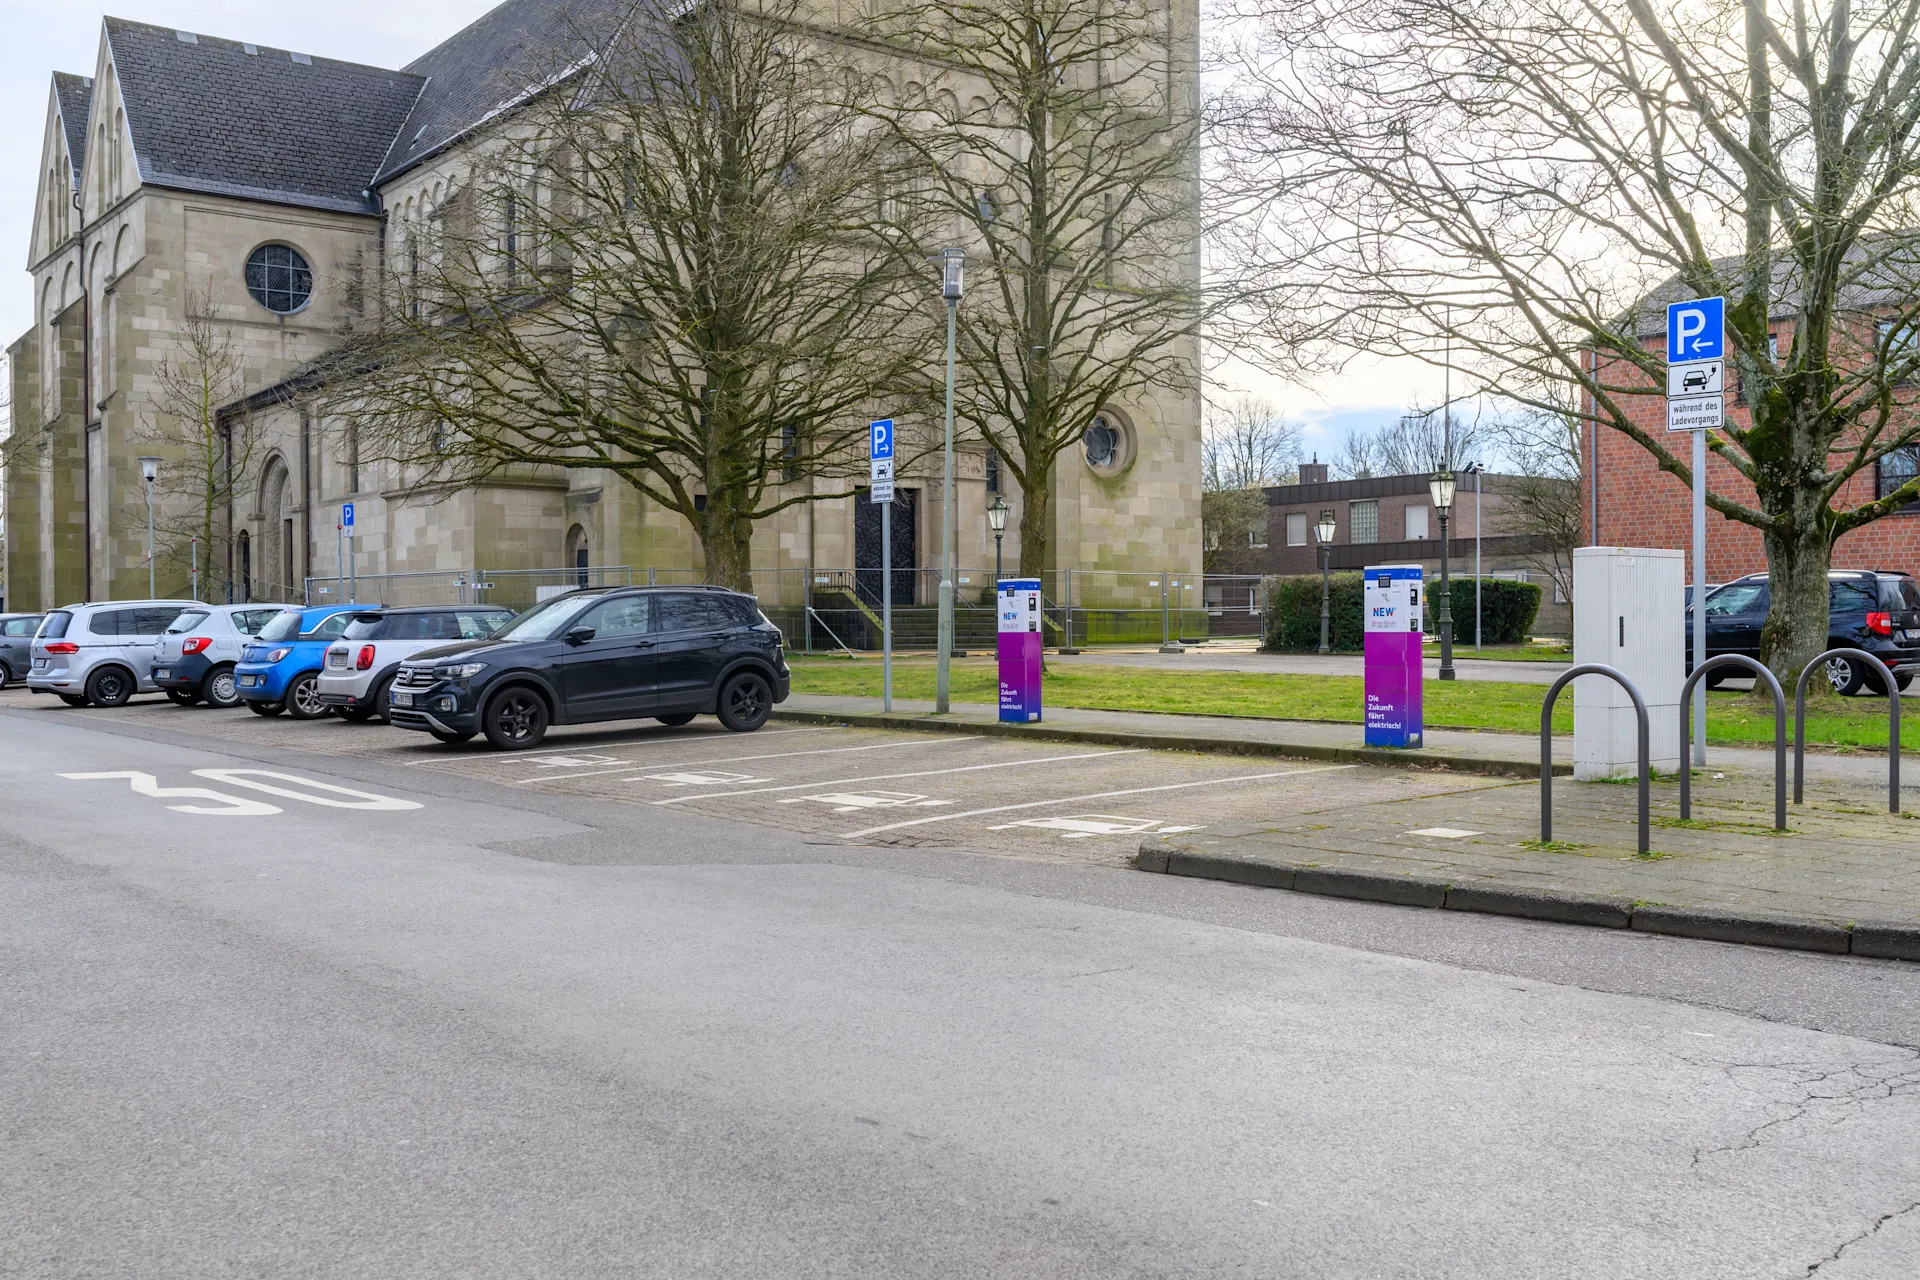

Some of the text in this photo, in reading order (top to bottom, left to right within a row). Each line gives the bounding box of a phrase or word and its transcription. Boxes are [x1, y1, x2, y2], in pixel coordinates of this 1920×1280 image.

[1677, 309, 1706, 355] P
[1673, 401, 1718, 414] während des
[1671, 414, 1719, 426] Ladevorgangs
[874, 425, 886, 455] P
[345, 507, 351, 524] P
[1003, 612, 1017, 620] NEW
[1373, 607, 1395, 617] NEW
[1368, 694, 1380, 702] Die
[1368, 703, 1394, 711] Zukunft
[1368, 712, 1385, 720] fährt
[1368, 721, 1402, 730] elektrisch!
[54, 768, 425, 816] 30
